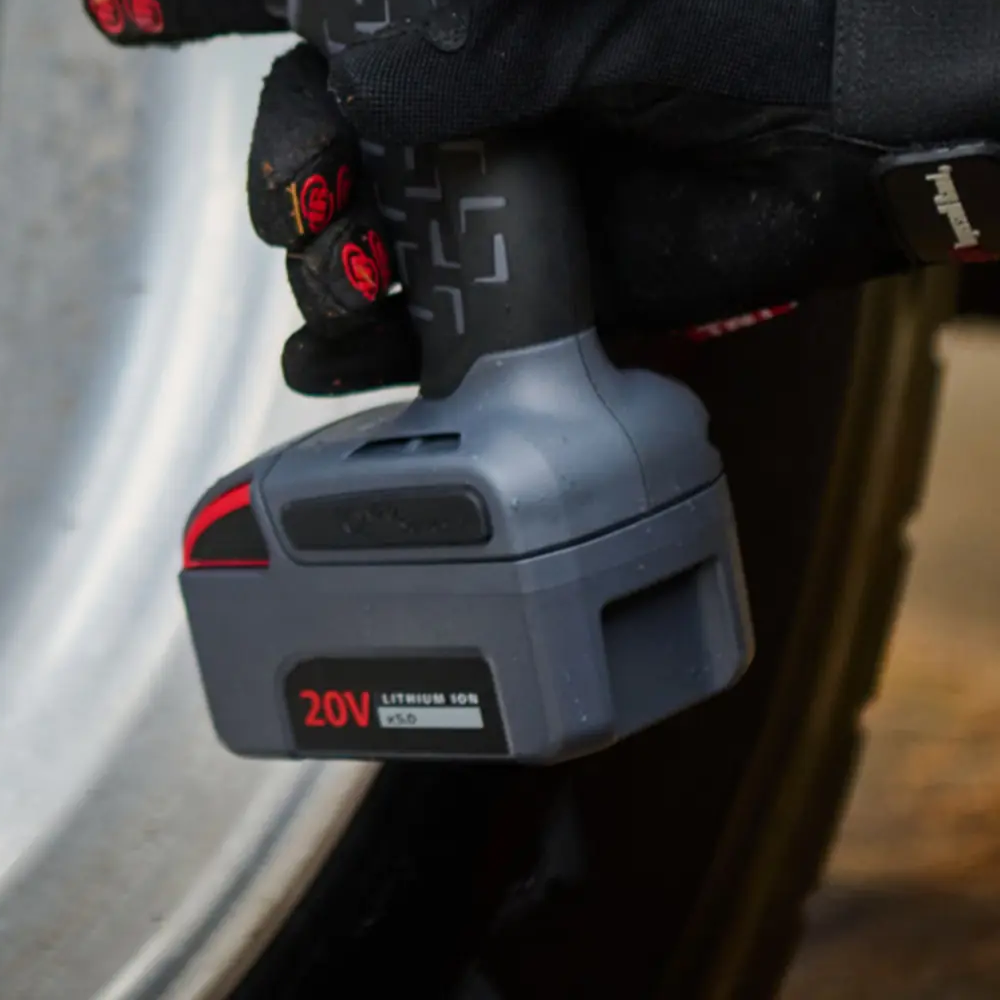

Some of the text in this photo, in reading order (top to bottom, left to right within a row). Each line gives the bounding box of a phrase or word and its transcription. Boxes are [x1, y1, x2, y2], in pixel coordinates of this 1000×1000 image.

[299, 689, 370, 727] 20V
[381, 692, 480, 705] LITHIUM ION
